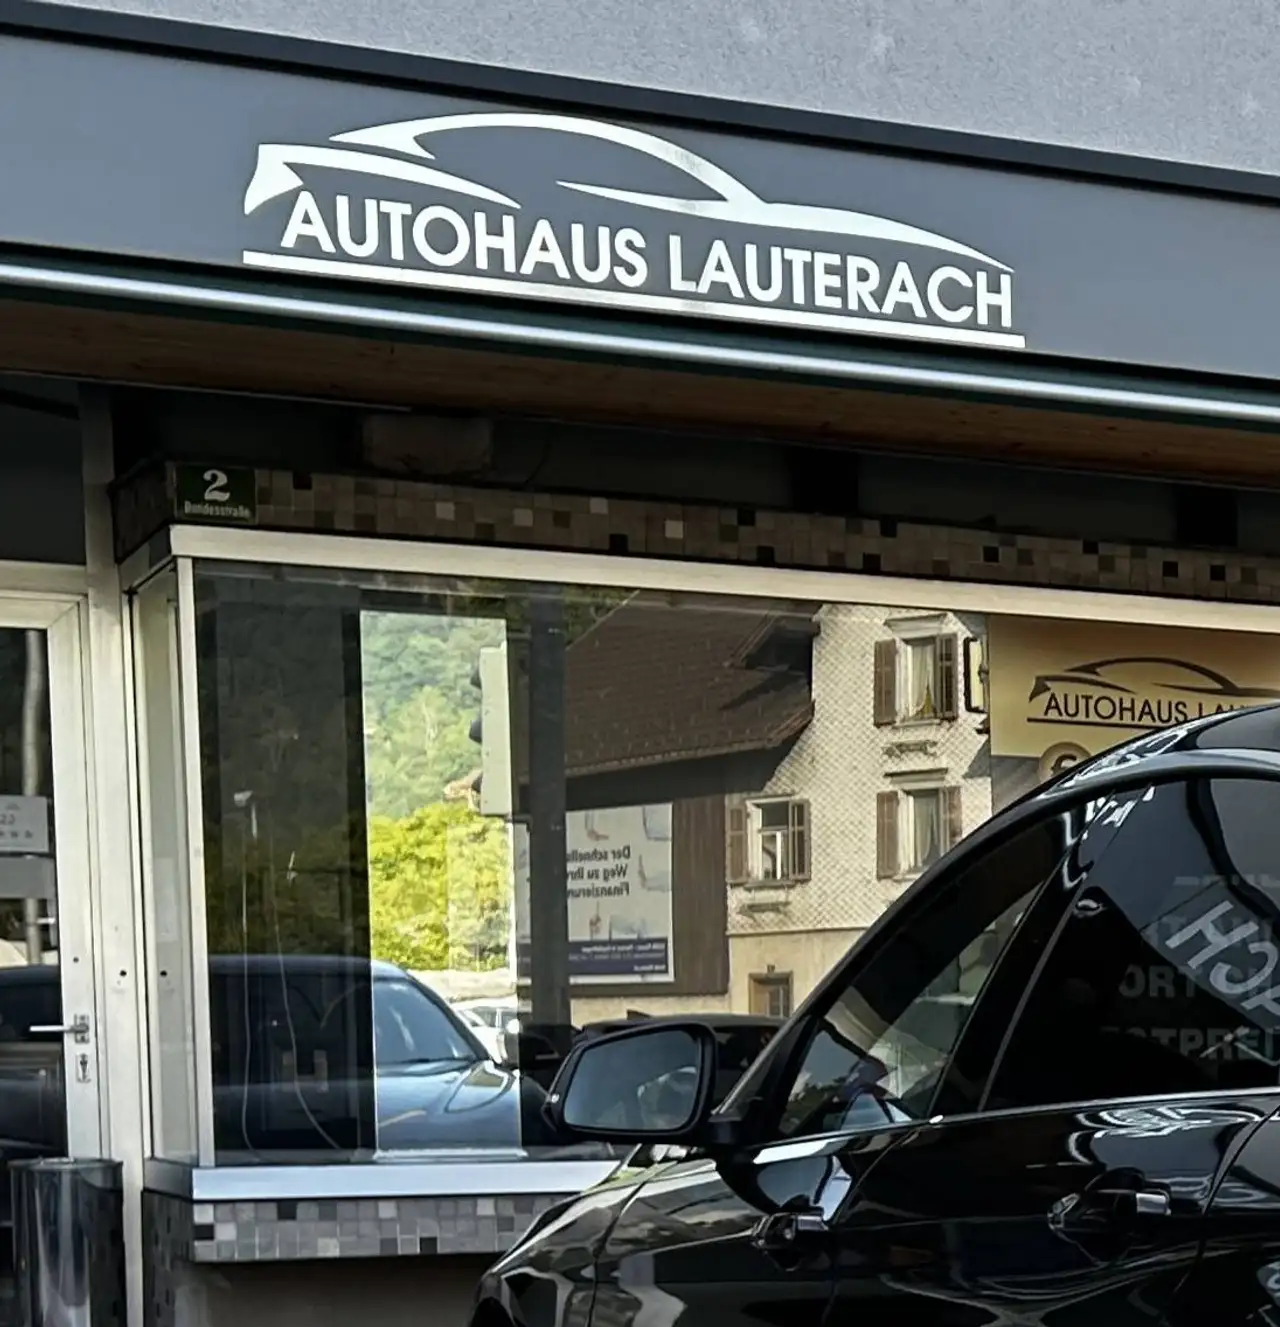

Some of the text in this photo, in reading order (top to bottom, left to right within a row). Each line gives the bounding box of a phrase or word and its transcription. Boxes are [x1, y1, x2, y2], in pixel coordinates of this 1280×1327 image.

[281, 190, 1013, 328] AUTOHAUS LAUTERACH
[203, 469, 230, 502] 2
[1044, 692, 1188, 724] AUTOHAUS
